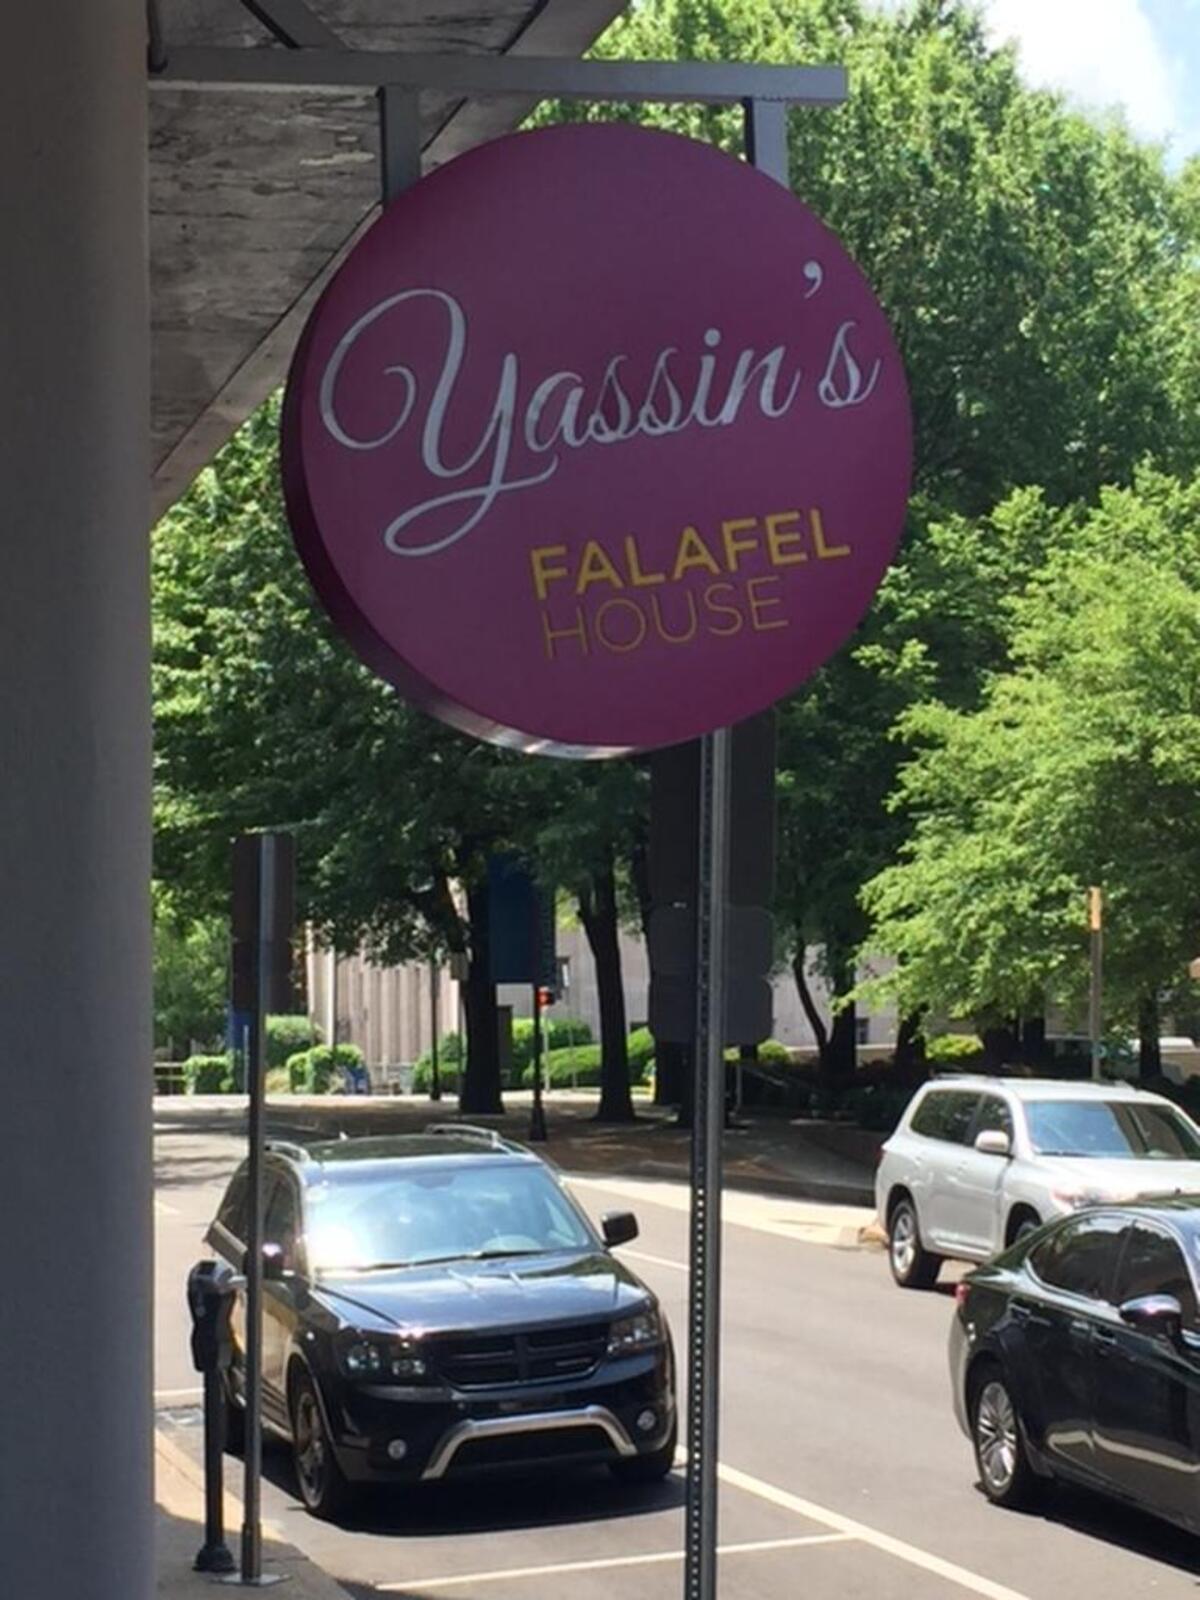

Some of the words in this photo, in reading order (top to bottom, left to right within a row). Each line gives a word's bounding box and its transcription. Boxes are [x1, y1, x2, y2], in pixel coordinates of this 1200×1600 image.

[320, 261, 880, 557] Yassin's
[531, 508, 851, 598] FALAFEL
[541, 576, 788, 659] HOUSE
